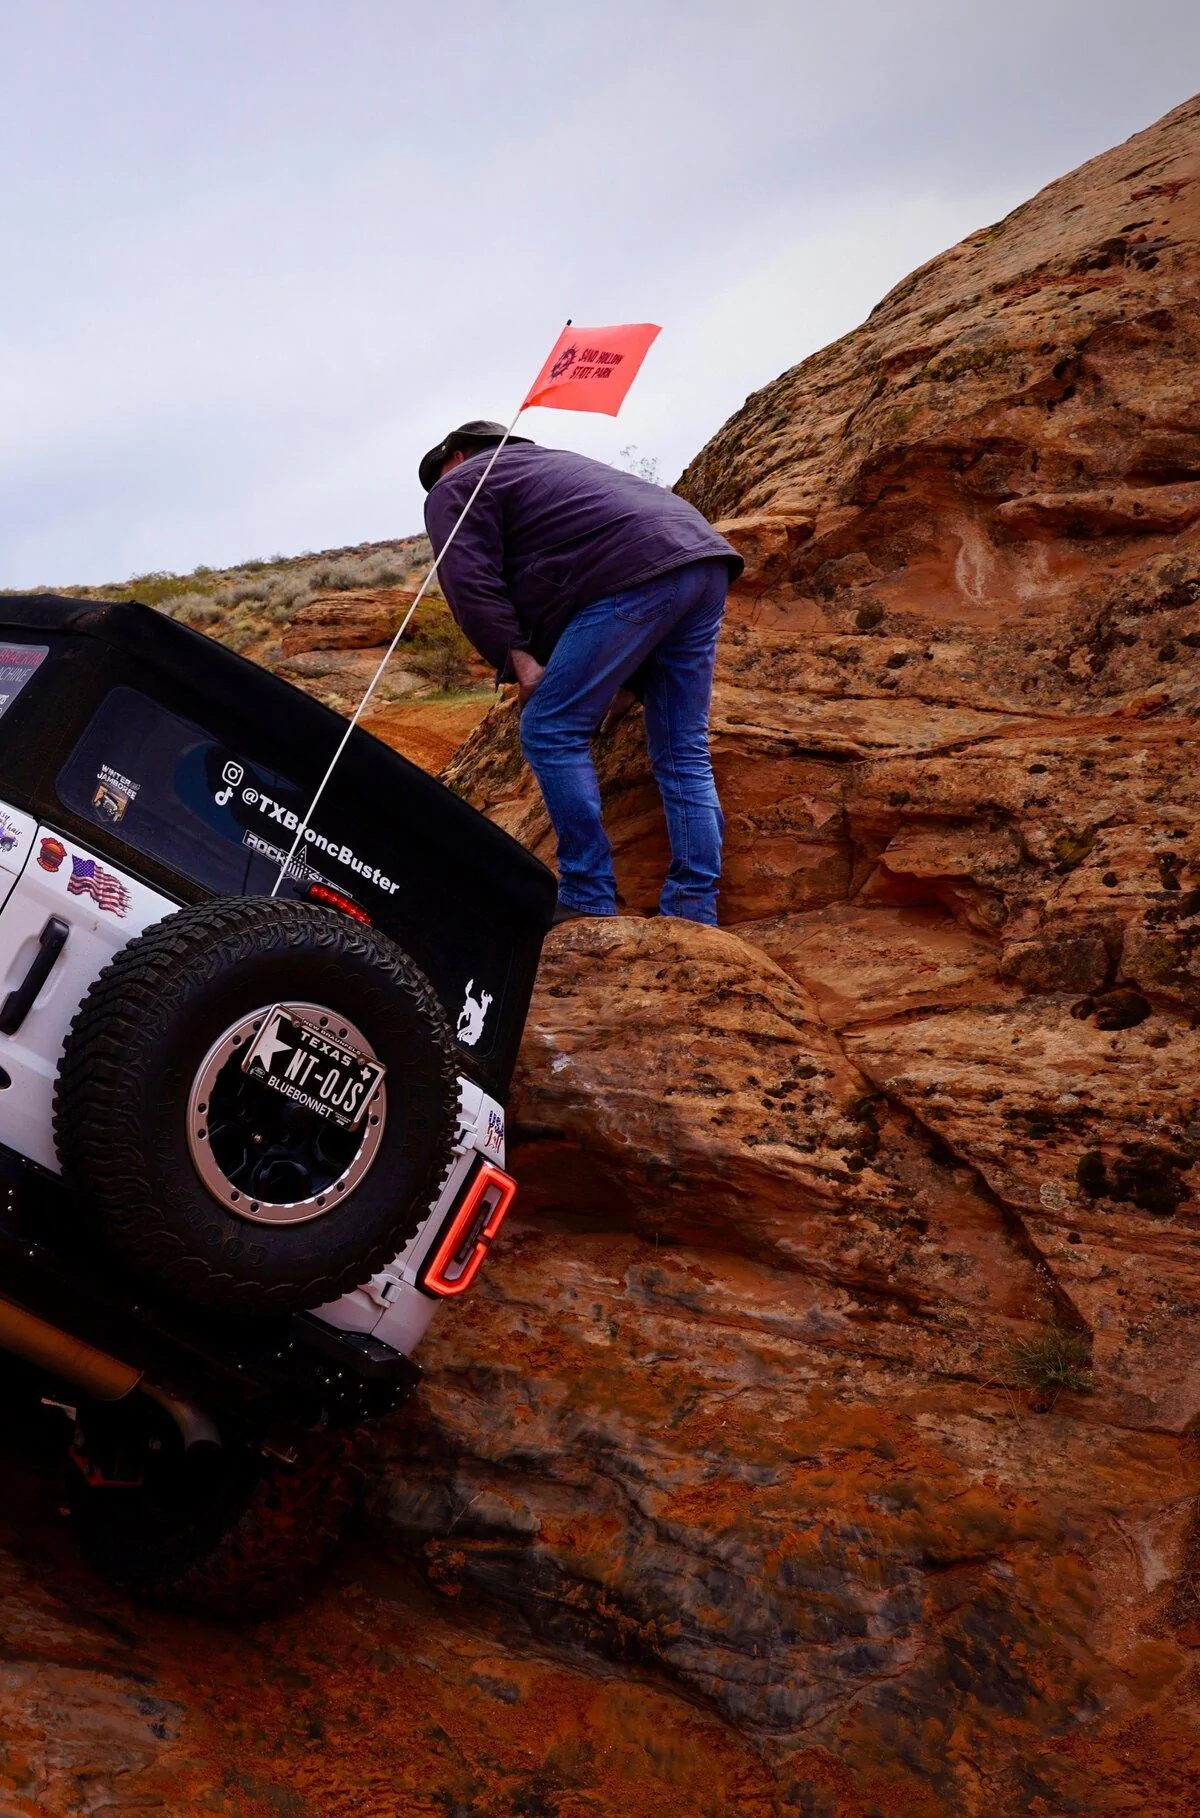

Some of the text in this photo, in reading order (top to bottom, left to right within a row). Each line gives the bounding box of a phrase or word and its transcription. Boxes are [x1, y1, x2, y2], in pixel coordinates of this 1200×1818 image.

[579, 348, 624, 366] SAND HOLLOW
[569, 366, 616, 379] STATE PARK
[97, 771, 137, 800] JAMBOREE
[101, 764, 132, 787] WINTER
[6, 822, 22, 836] hair
[241, 787, 400, 895] @TXBroncBuster
[246, 833, 289, 866] ROCK
[303, 1018, 321, 1032] NEW
[300, 1030, 352, 1067] TEXAS
[267, 1075, 334, 1118] BLUEBONNET
